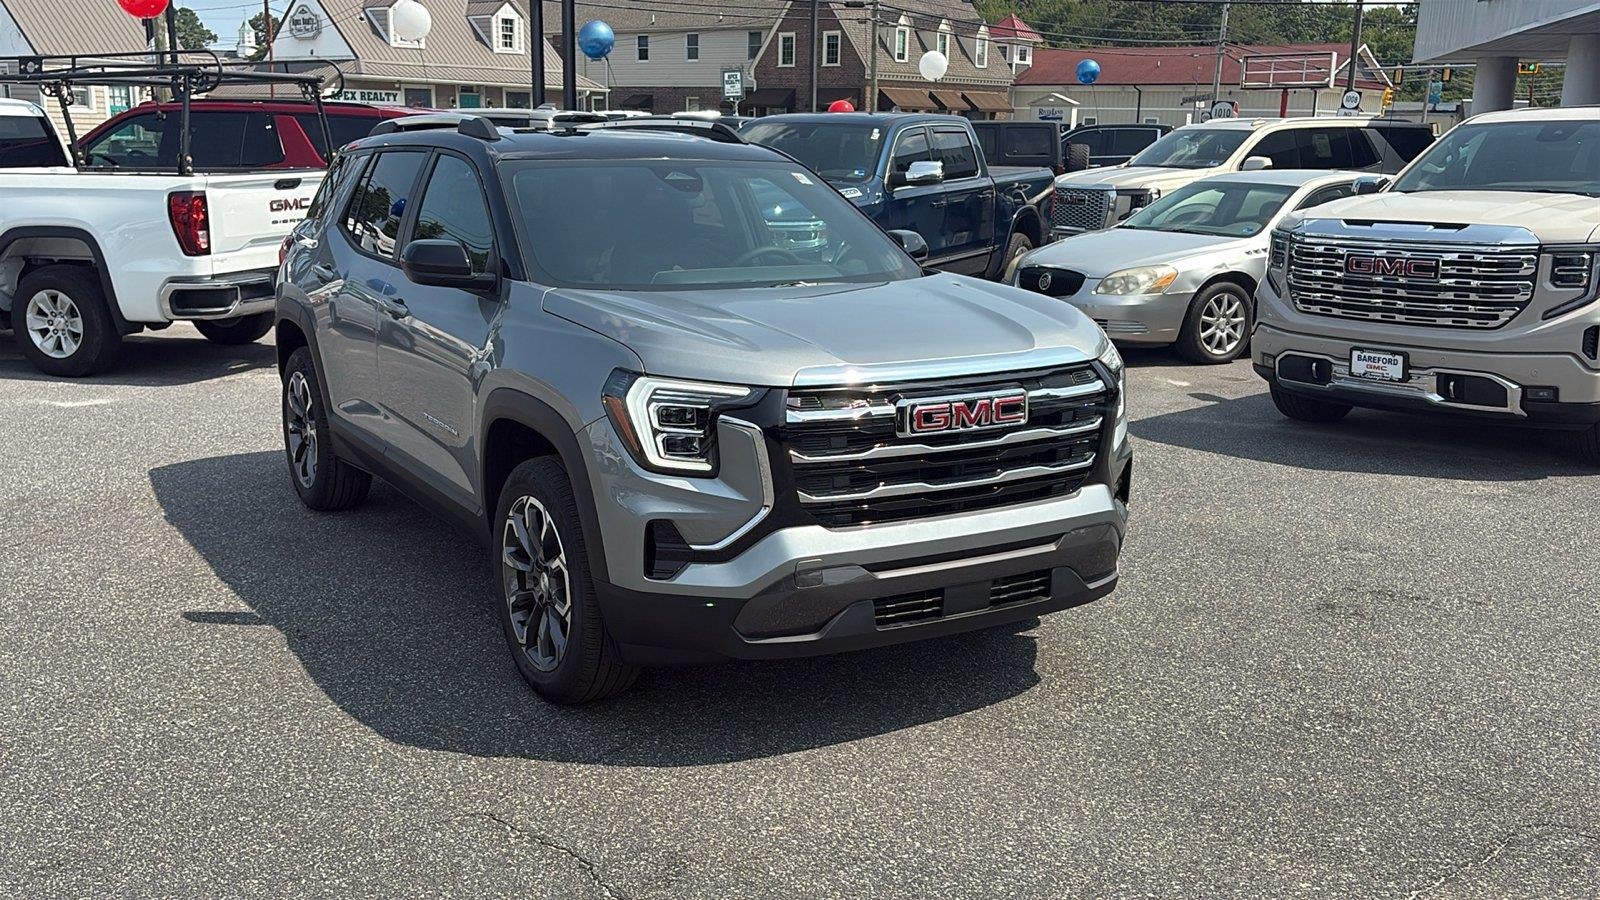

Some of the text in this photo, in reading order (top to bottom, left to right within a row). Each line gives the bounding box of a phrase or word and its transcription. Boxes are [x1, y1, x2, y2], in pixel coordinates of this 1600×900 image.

[360, 91, 398, 102] REALTY
[1214, 108, 1231, 118] 1010
[269, 197, 311, 212] GMC
[1348, 256, 1437, 278] GMC
[1356, 354, 1399, 366] BAREFORD
[1365, 363, 1388, 371] GMC
[913, 395, 1026, 433] GMC
